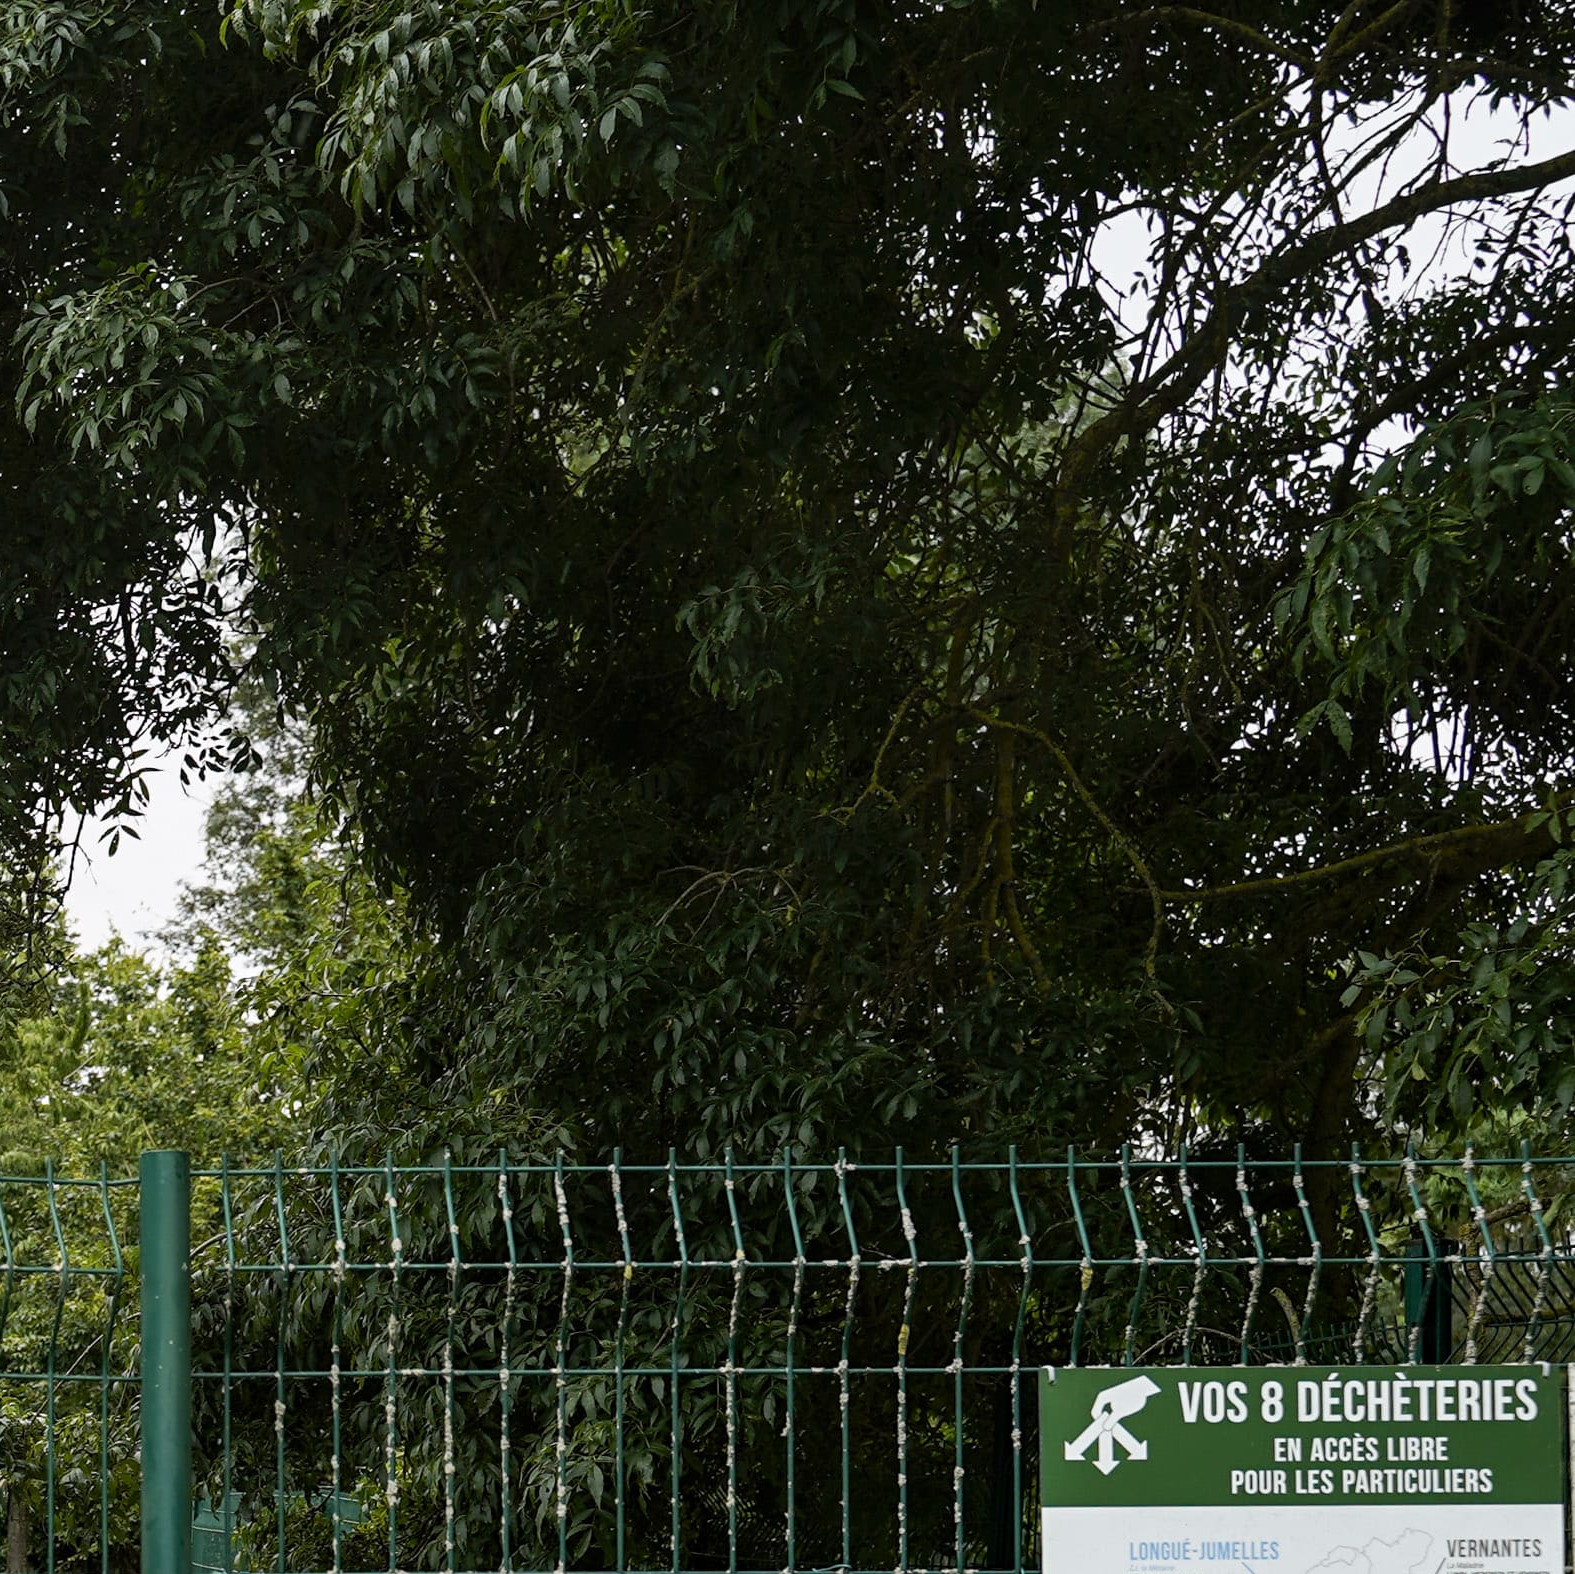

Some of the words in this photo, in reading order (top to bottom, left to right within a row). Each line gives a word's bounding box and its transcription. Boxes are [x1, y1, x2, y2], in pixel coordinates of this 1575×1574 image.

[1178, 1381, 1248, 1423] VOS
[1261, 1381, 1284, 1423] 8
[1298, 1372, 1539, 1422] DÉCHÈTERIES
[1274, 1438, 1301, 1462] EN
[1310, 1433, 1378, 1462] ACCÈS
[1387, 1437, 1449, 1461] LIBRE
[1231, 1470, 1287, 1494] POUR
[1295, 1469, 1334, 1494] LES
[1343, 1468, 1493, 1494] PARTICULIERS
[1130, 1539, 1279, 1560] LONGUÉ-JUMELLES
[1447, 1539, 1541, 1557] VERNANTES
